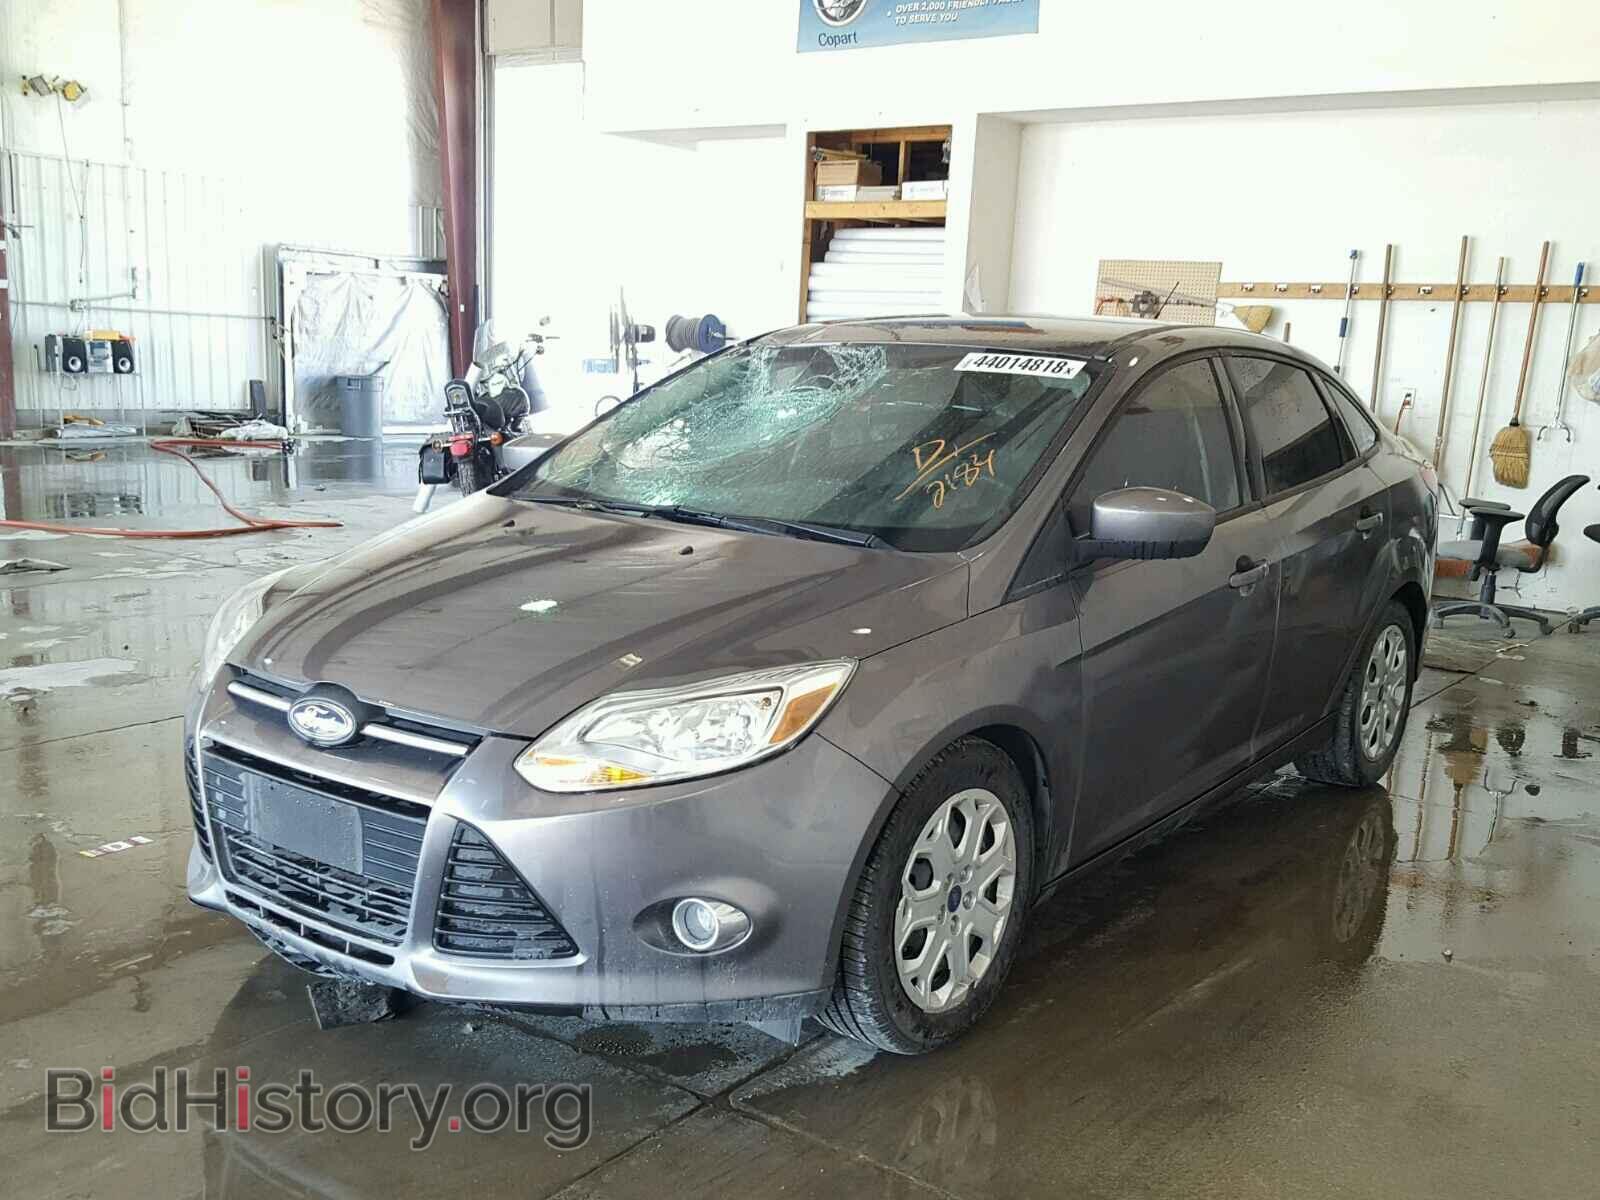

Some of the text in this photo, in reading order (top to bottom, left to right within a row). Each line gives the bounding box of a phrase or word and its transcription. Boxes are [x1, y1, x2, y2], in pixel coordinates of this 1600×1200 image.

[895, 4, 920, 14] OVER
[921, 2, 945, 12] 2,000
[895, 16, 907, 25] TO
[908, 14, 937, 24] SERVE
[818, 32, 858, 48] Copart
